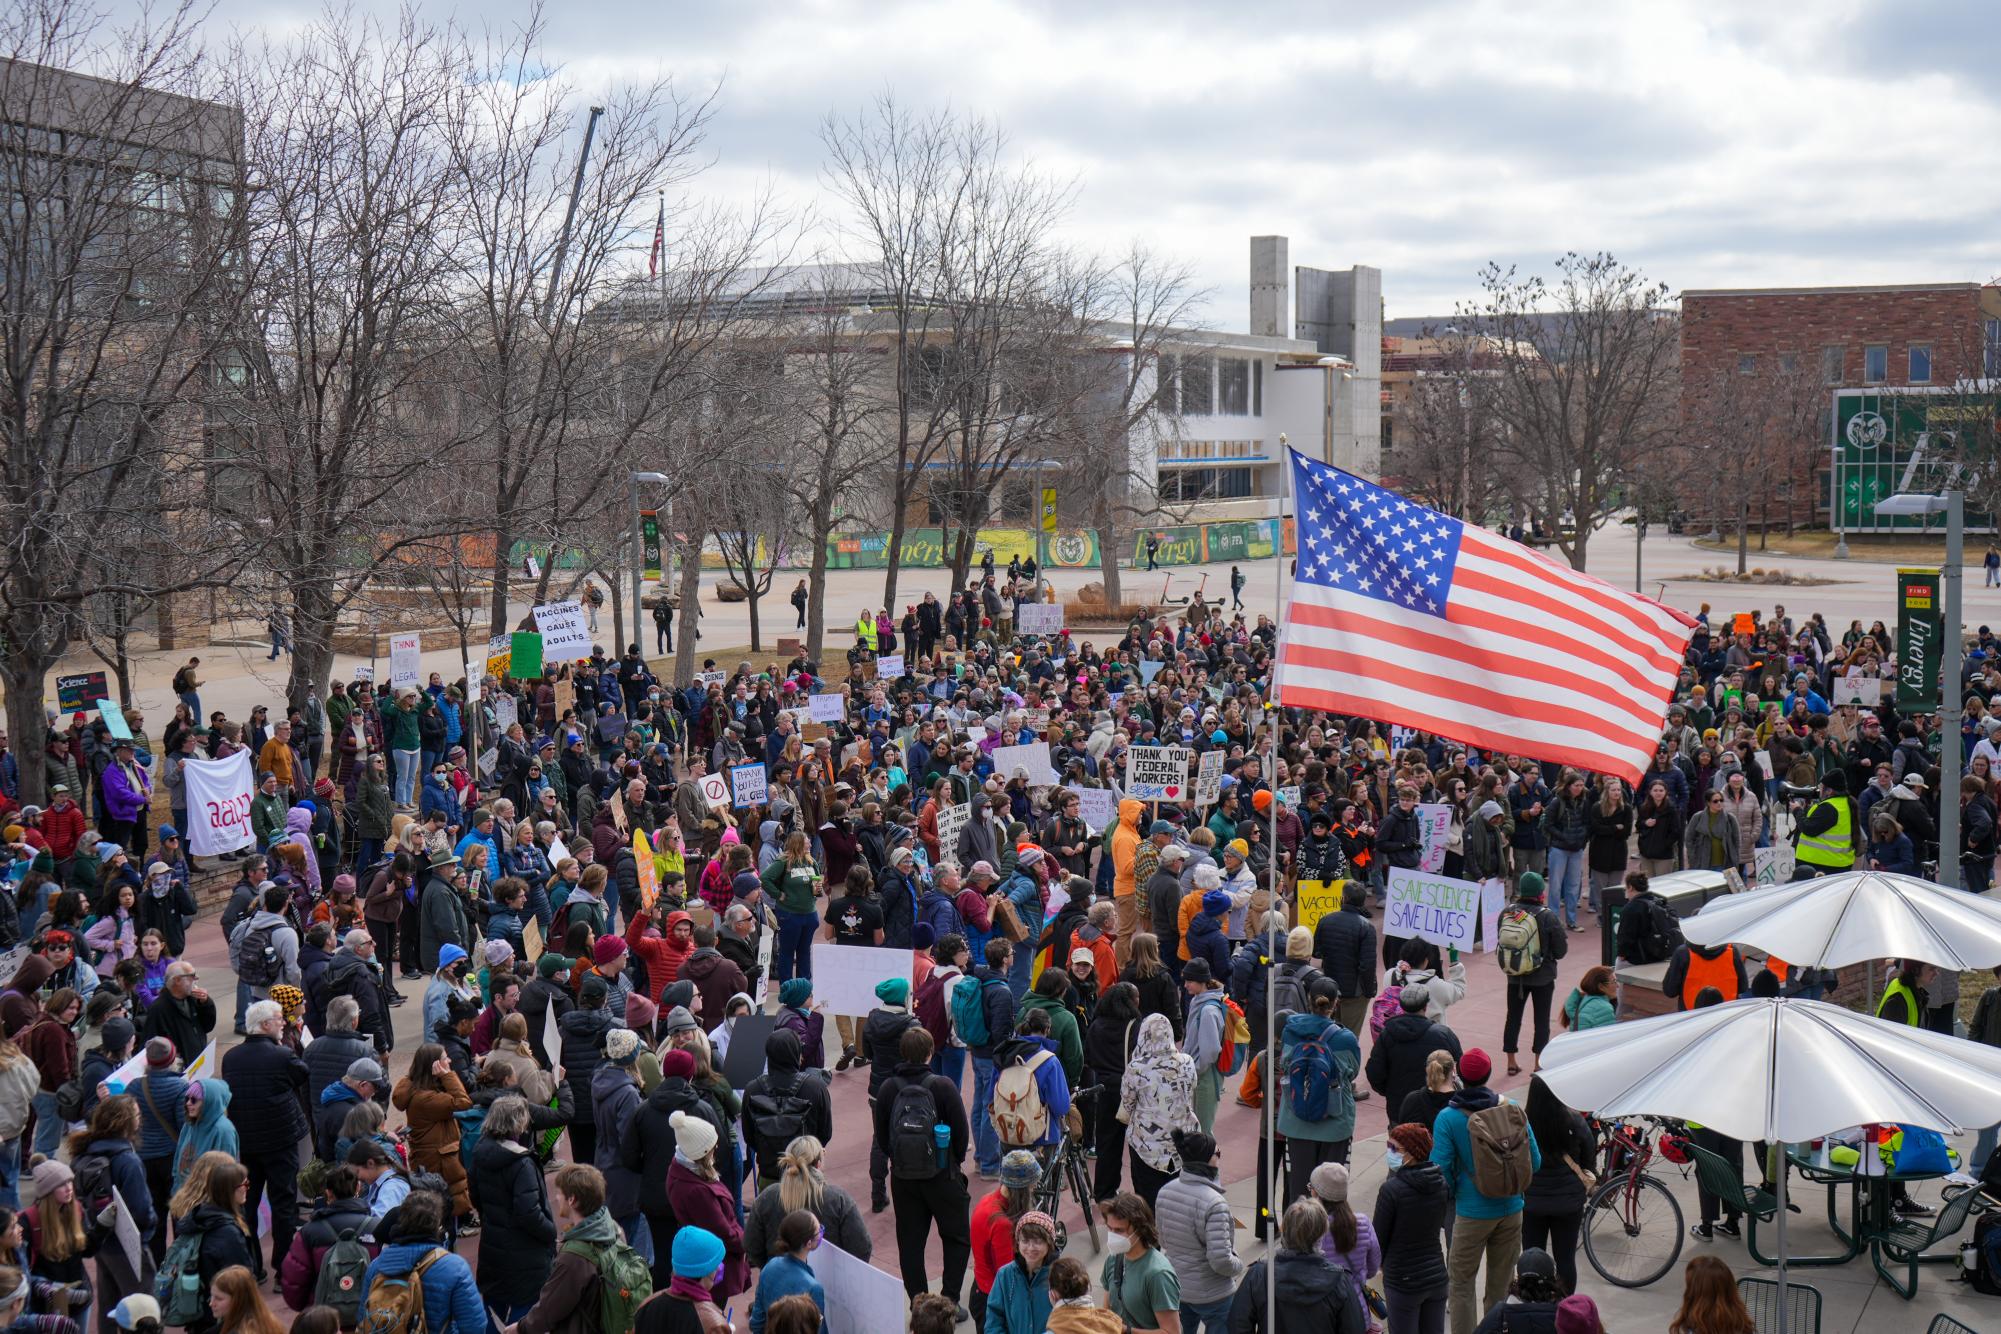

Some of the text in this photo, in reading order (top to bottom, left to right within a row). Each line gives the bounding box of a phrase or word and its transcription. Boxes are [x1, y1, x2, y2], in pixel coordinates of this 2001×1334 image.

[1908, 587, 1928, 595] FIND
[535, 605, 580, 619] VACCINES
[546, 620, 577, 632] CAUSE
[393, 640, 417, 651] THINK
[546, 633, 585, 647] ADULTS
[1901, 616, 1932, 697] Energy
[57, 676, 89, 691] Science
[394, 671, 419, 682] LEGAL
[703, 672, 724, 682] SCIENCE
[1130, 748, 1188, 762] THANK YOU
[736, 768, 762, 780] THANK
[1135, 761, 1180, 774] FEDERAL
[735, 777, 764, 792] YOU REP
[1133, 773, 1184, 786] WORKERS!
[737, 792, 749, 803] AL
[937, 804, 968, 821] WHEN THE
[952, 812, 969, 823] TREE
[1432, 812, 1449, 837] life!
[1391, 878, 1477, 914] SAVE SCIENCE
[1300, 896, 1344, 911] VACCIN
[1390, 902, 1468, 939] SAVE LIVES
